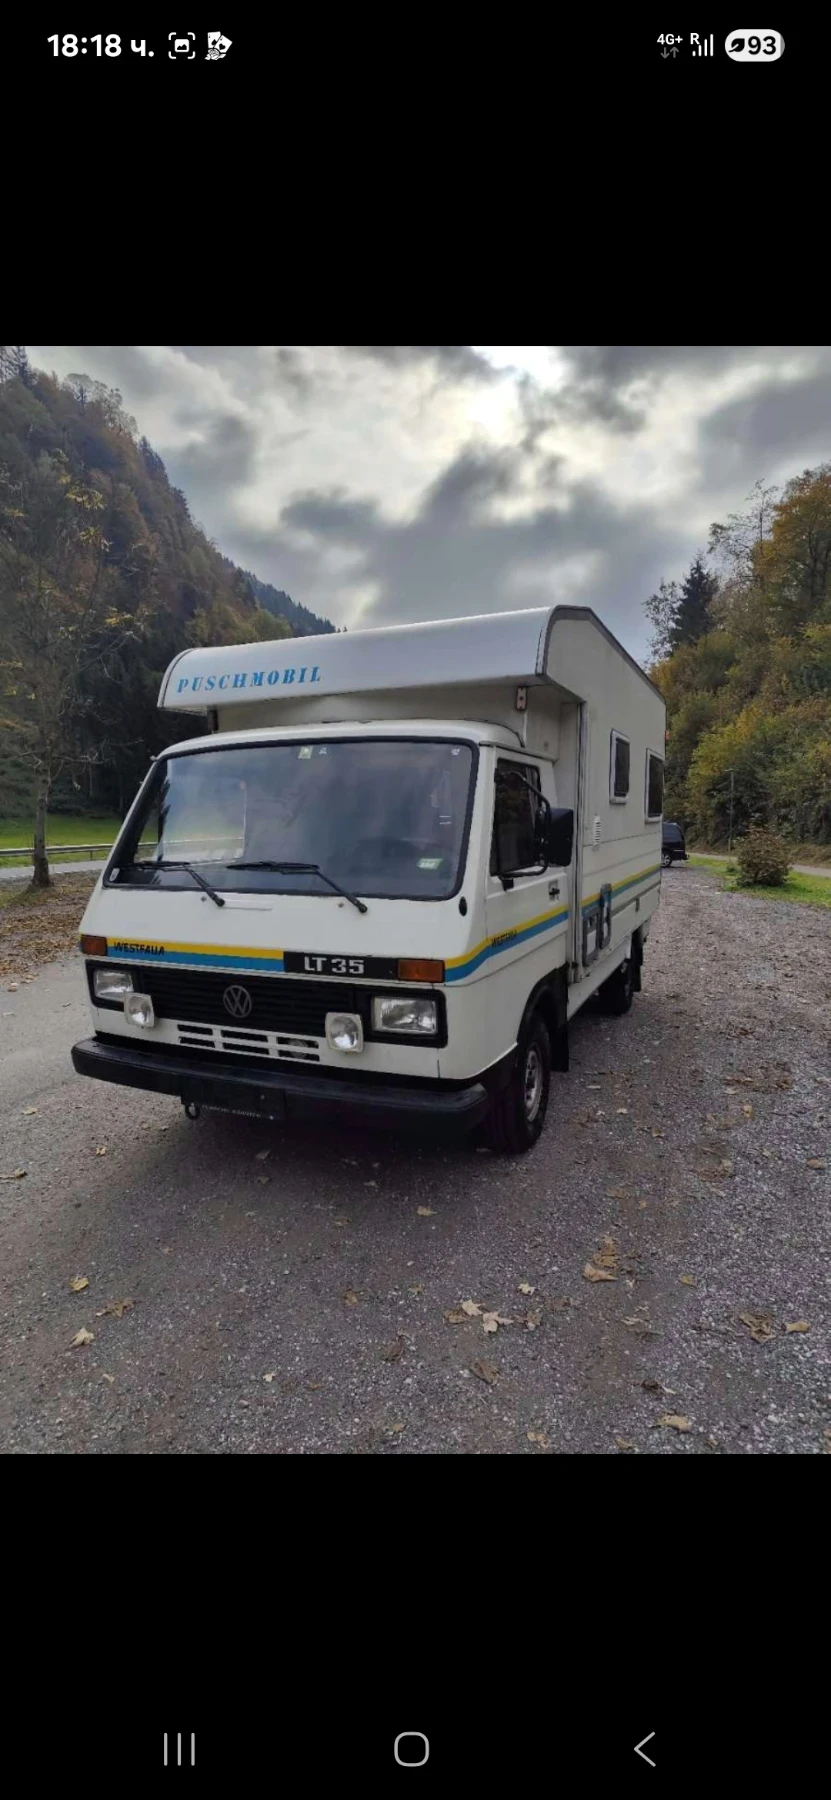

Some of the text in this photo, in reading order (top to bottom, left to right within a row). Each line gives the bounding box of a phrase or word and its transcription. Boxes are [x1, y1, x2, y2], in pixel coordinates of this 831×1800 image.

[177, 666, 321, 693] PUSCHMOBIL
[304, 955, 365, 975] LT 35
